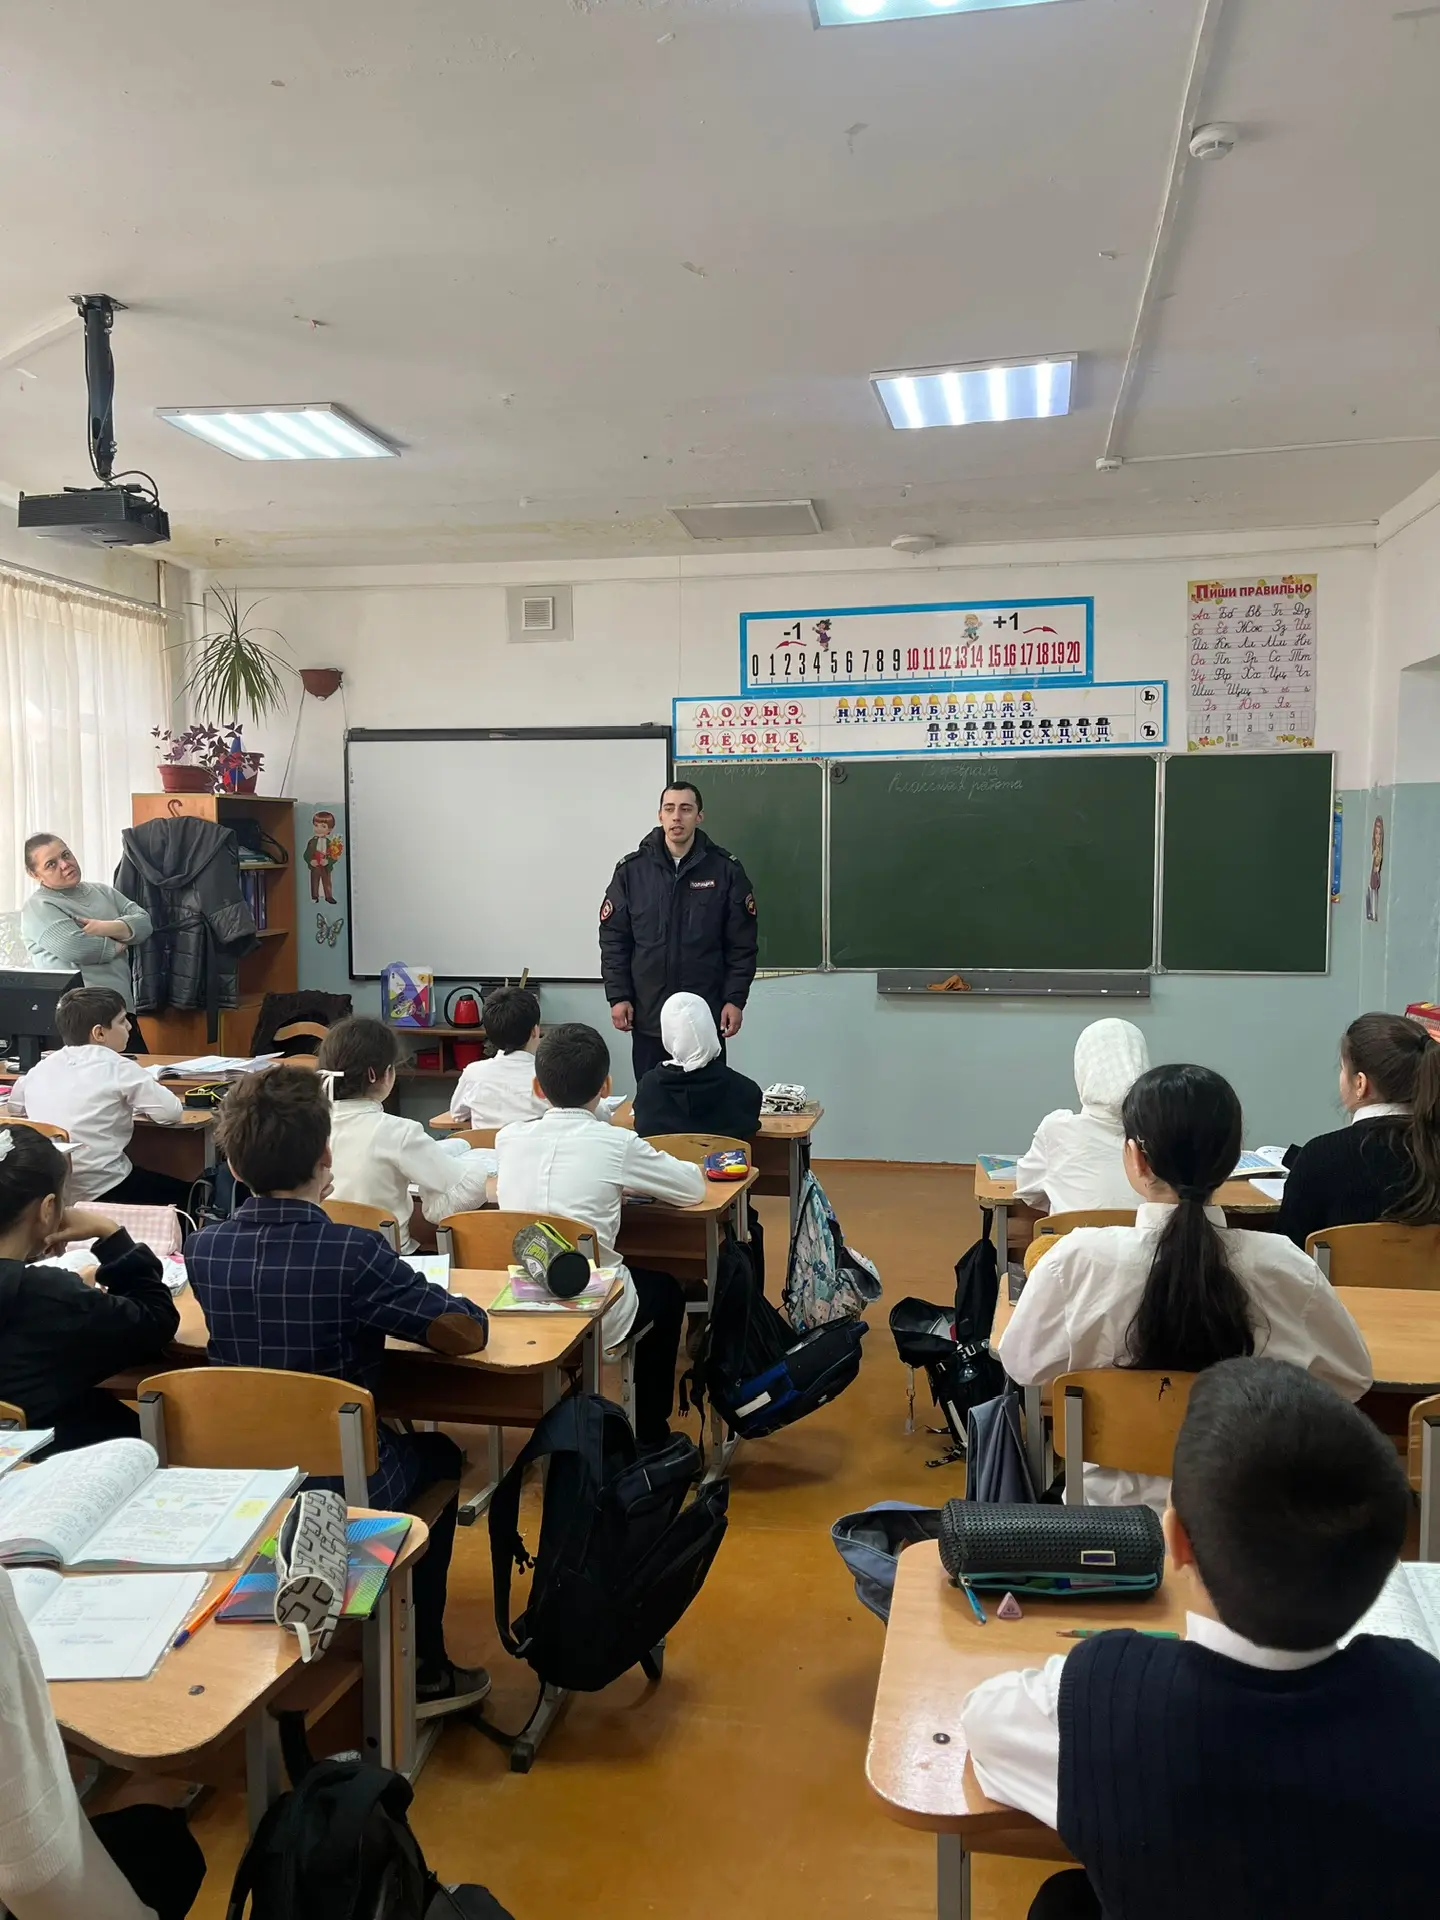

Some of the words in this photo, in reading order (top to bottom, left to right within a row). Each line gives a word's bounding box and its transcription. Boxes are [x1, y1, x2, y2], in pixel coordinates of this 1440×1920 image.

[784, 622, 801, 639] -1
[993, 612, 1019, 630] +1
[752, 655, 758, 676] 0
[770, 654, 775, 675] 1
[785, 653, 791, 675] 2
[799, 653, 805, 675] 3
[813, 652, 820, 673] 4
[831, 652, 837, 673] 5
[846, 651, 852, 673] 6
[863, 650, 869, 672] 7
[877, 650, 883, 672] 8
[893, 649, 900, 671] 9
[907, 649, 919, 670] 10
[923, 647, 935, 670] 11
[939, 647, 951, 669] 12
[954, 646, 967, 669] 13
[971, 645, 983, 668] 14
[988, 645, 1000, 667] 15
[1003, 644, 1016, 667] 16
[1021, 643, 1033, 665] 17
[1036, 642, 1049, 665] 18
[1051, 642, 1064, 664] 19
[1067, 641, 1080, 663] 20
[700, 708, 710, 718] А
[722, 707, 732, 717] О
[744, 707, 753, 717] У
[764, 706, 778, 716] Ы
[788, 706, 798, 715] Э
[838, 709, 848, 717] Н
[856, 709, 866, 717] М
[874, 708, 884, 716] Л
[893, 707, 901, 715] Р
[930, 706, 938, 714] Б
[948, 705, 956, 713] В
[967, 704, 974, 712] Г
[985, 703, 994, 712] Д
[1002, 703, 1013, 711] Ж
[1022, 702, 1031, 711] З
[700, 735, 709, 745] Я
[722, 733, 731, 746] Ё
[741, 734, 756, 744] Ю
[766, 734, 777, 743] И
[789, 733, 799, 742] Е
[947, 732, 958, 740] Ф
[966, 732, 976, 740] К
[985, 731, 994, 739] Т
[1022, 730, 1031, 738] С
[1041, 730, 1050, 738] Х
[1060, 729, 1069, 738] Ц
[1079, 728, 1088, 736] Ч
[1098, 726, 1108, 736] Щ
